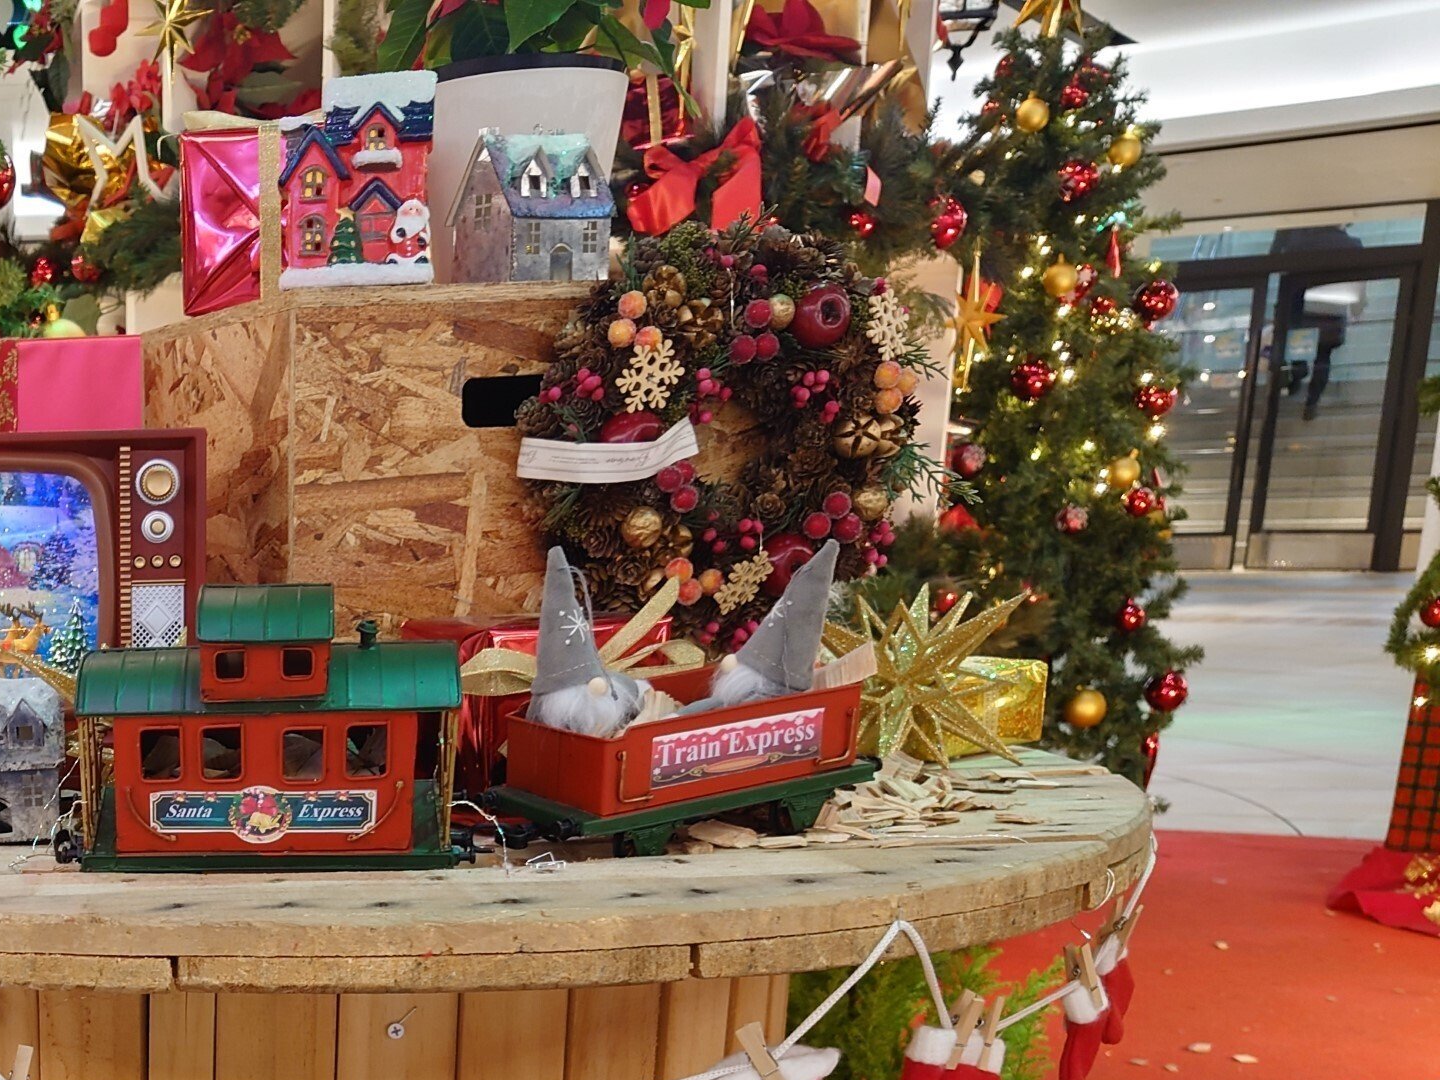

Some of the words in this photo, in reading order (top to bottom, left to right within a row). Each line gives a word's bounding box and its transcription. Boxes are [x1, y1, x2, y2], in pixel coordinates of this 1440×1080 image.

[658, 738, 720, 768] Train
[726, 723, 816, 756] Express
[165, 804, 213, 819] Santa
[297, 804, 365, 822] Express
